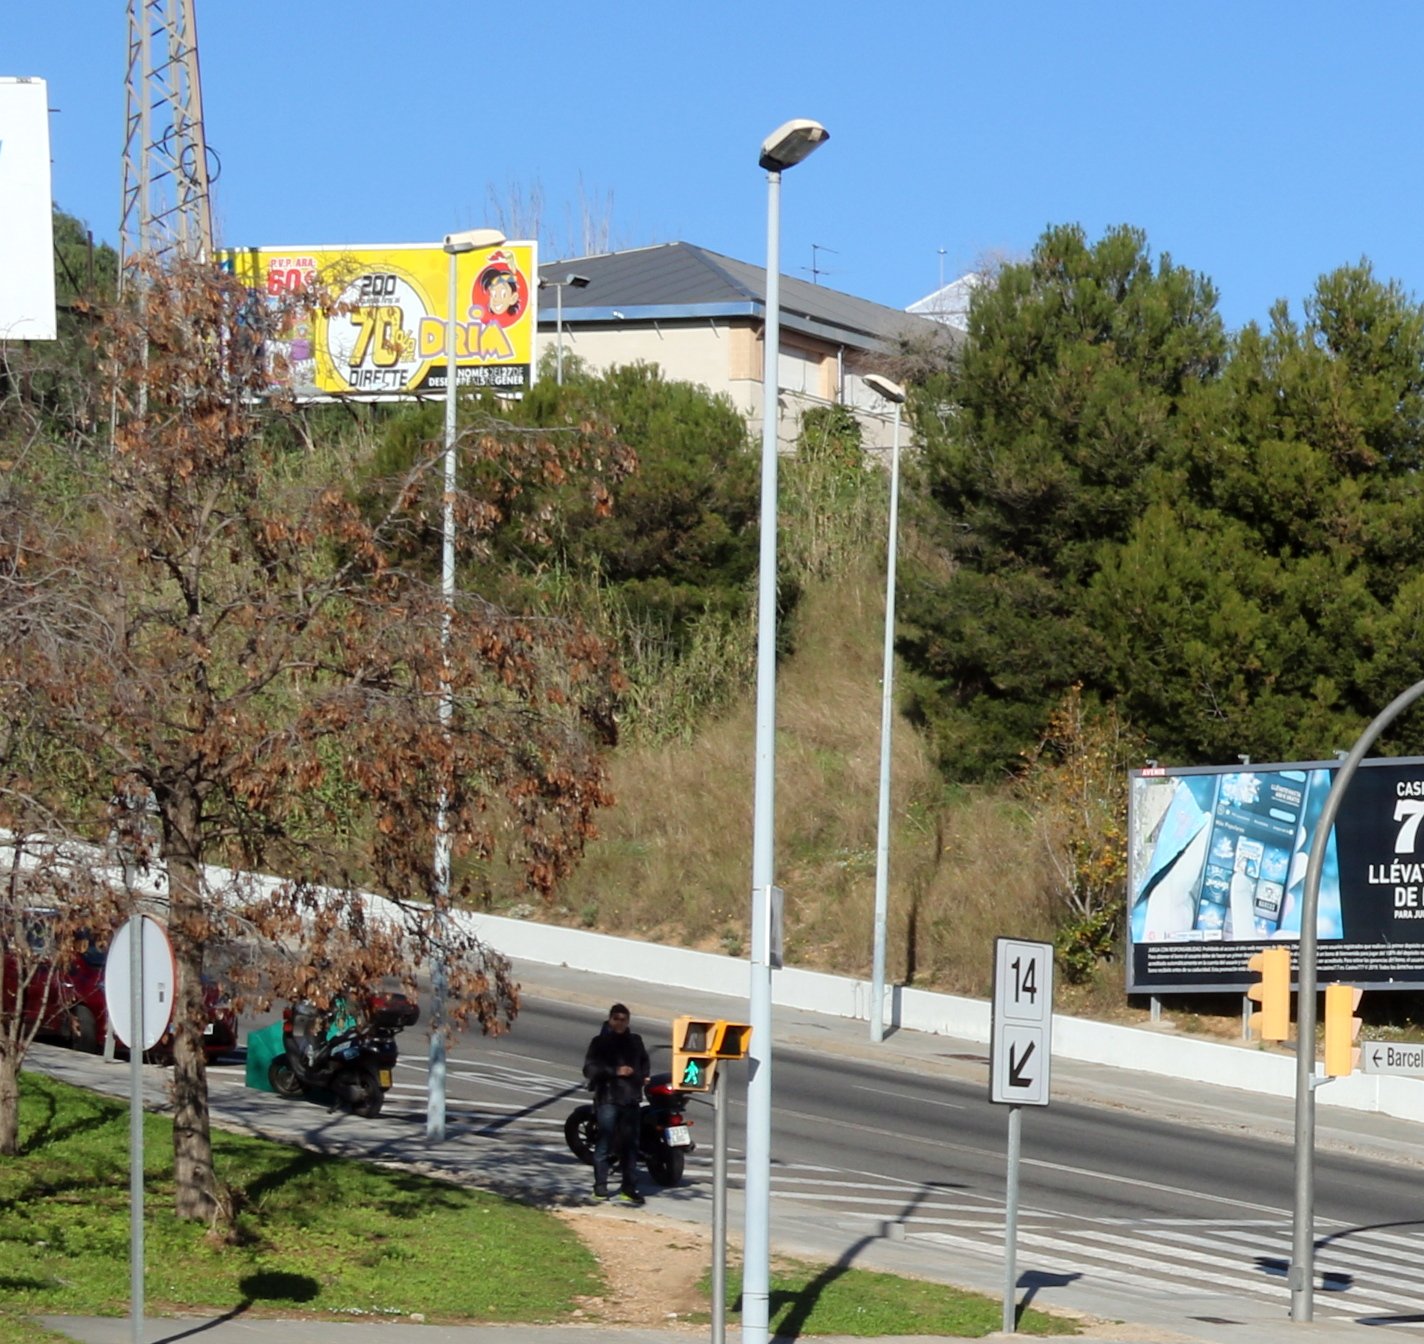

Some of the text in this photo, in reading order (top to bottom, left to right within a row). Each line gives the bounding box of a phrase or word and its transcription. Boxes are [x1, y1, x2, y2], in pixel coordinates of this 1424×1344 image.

[361, 276, 396, 296] 200
[350, 369, 408, 387] DIRECTE
[501, 367, 512, 376] 27
[1142, 768, 1166, 776] AVENIR
[1394, 887, 1418, 907] DE
[1394, 911, 1413, 919] PARA
[1011, 956, 1037, 1005] 14
